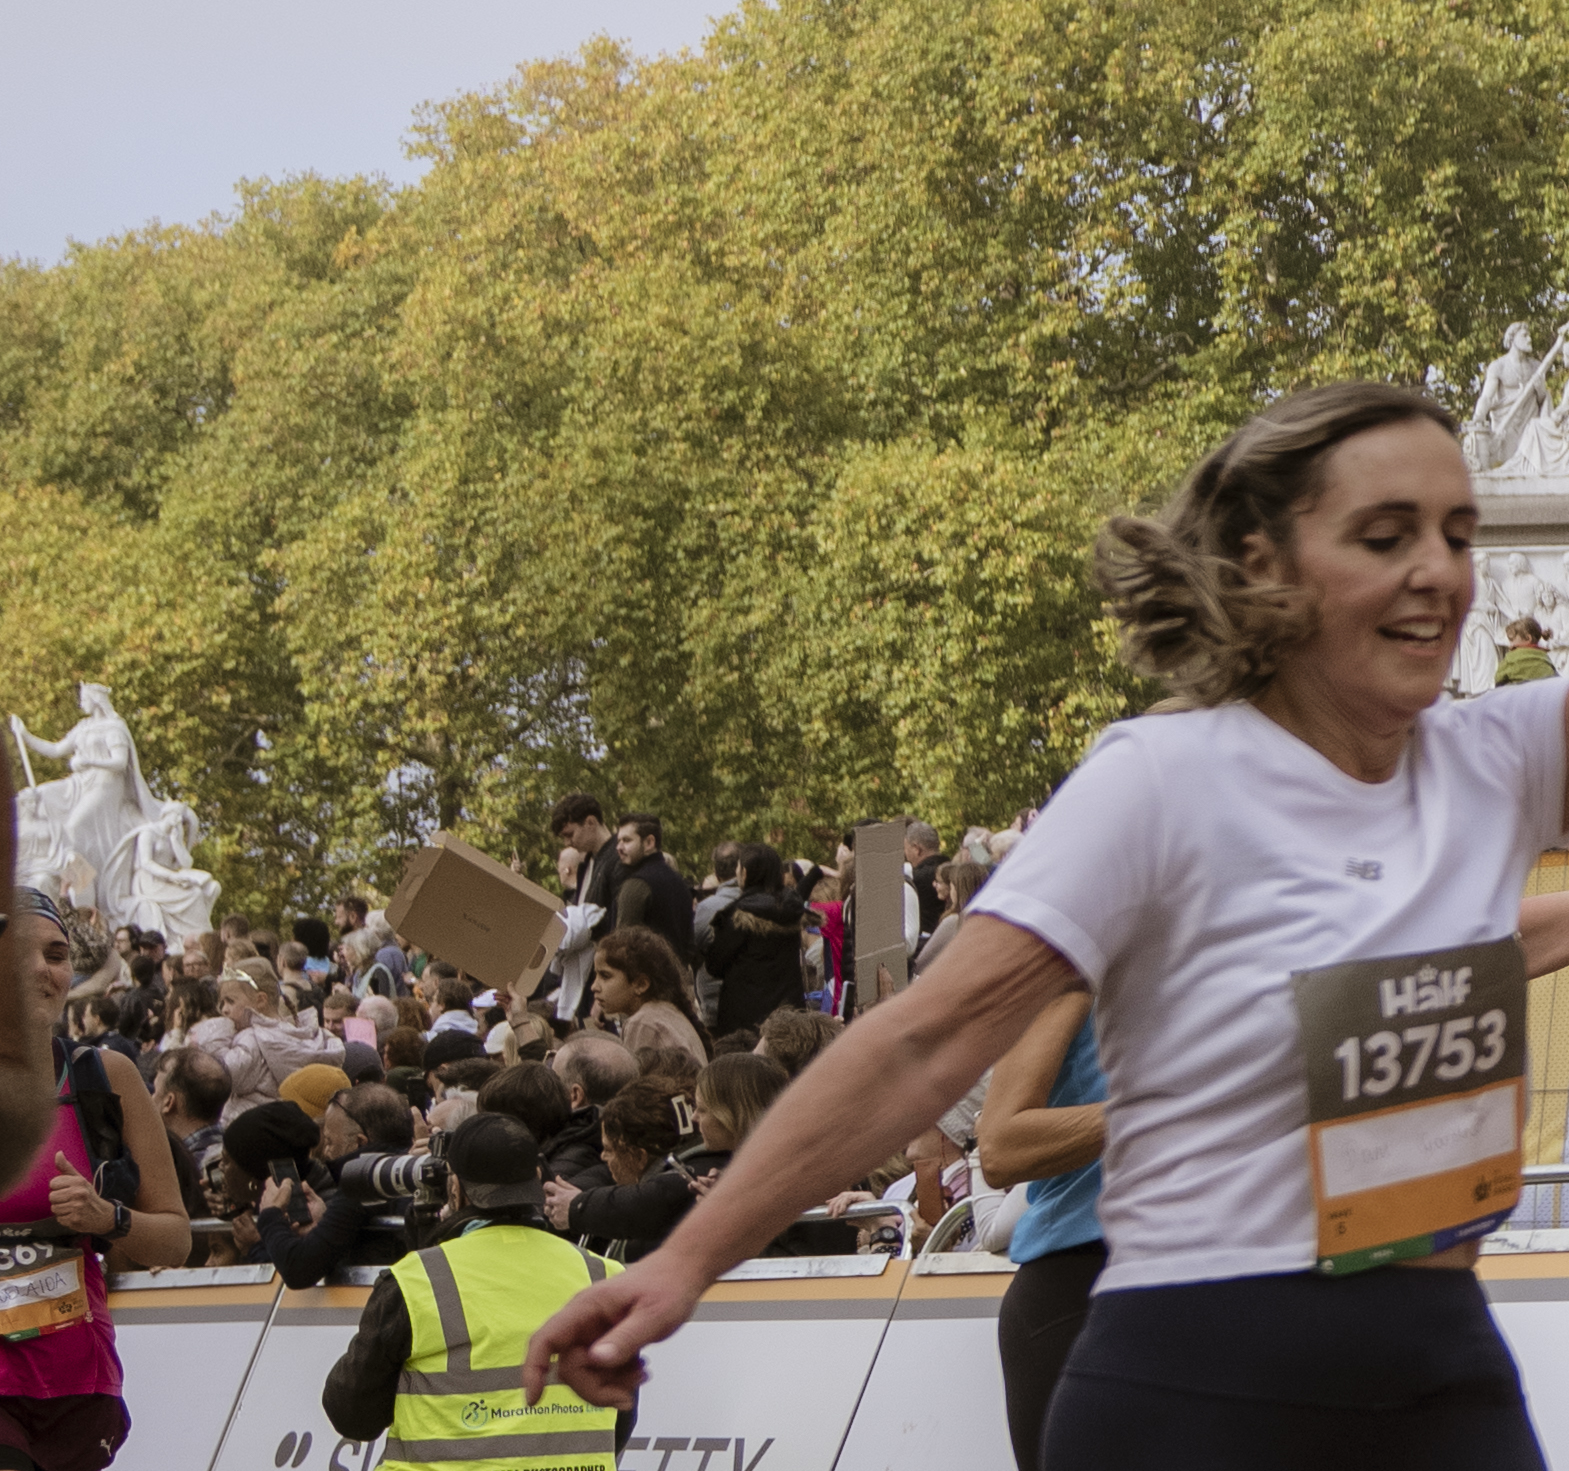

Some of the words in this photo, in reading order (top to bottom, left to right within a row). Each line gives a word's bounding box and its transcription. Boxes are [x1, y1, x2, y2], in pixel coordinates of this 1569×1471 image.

[1378, 966, 1472, 1018] Half
[1334, 1009, 1507, 1101] 13753
[491, 1405, 549, 1419] Marathon
[551, 1403, 583, 1415] Photos
